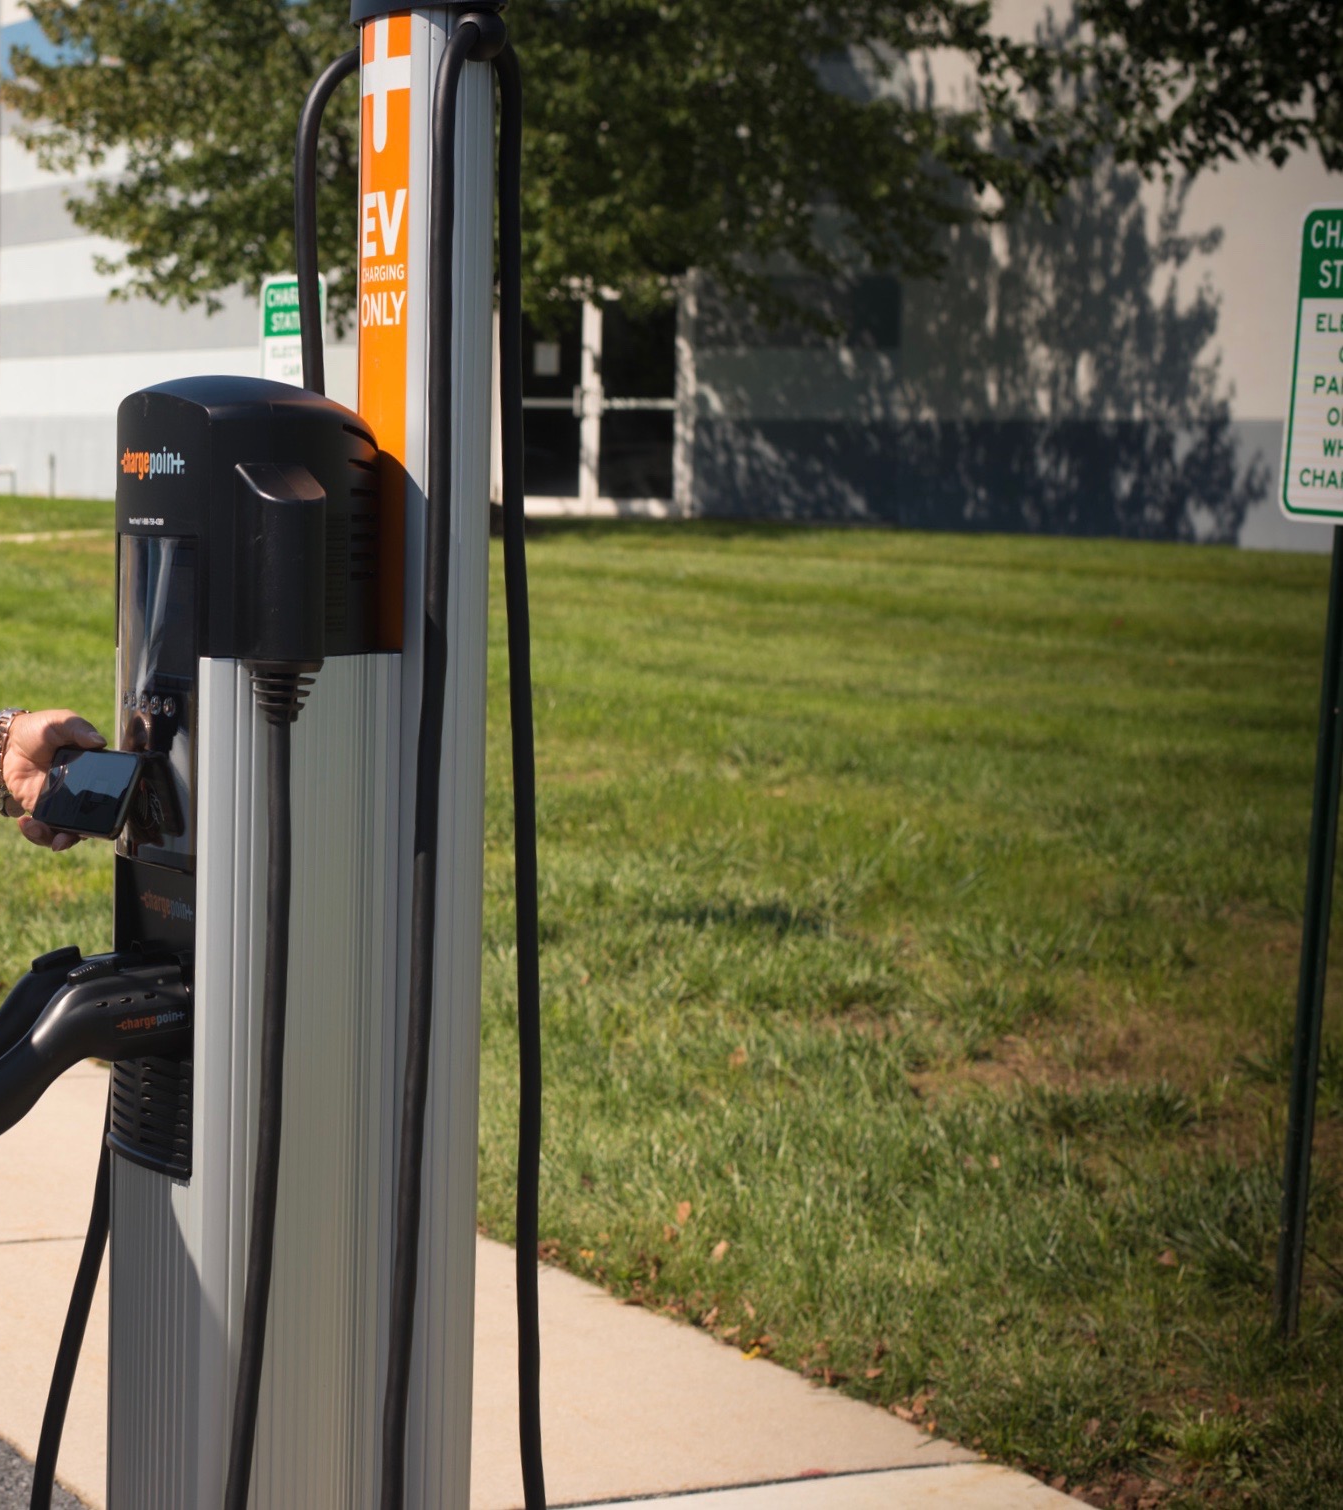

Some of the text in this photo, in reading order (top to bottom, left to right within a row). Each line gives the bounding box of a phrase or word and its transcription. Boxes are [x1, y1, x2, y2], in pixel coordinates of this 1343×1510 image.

[362, 188, 407, 258] EV
[1310, 219, 1343, 249] CH
[362, 263, 405, 284] CHARGING
[362, 290, 406, 328] ONLY
[1315, 312, 1343, 333] EL
[1313, 375, 1343, 395] PA
[1299, 467, 1343, 490] CHA
